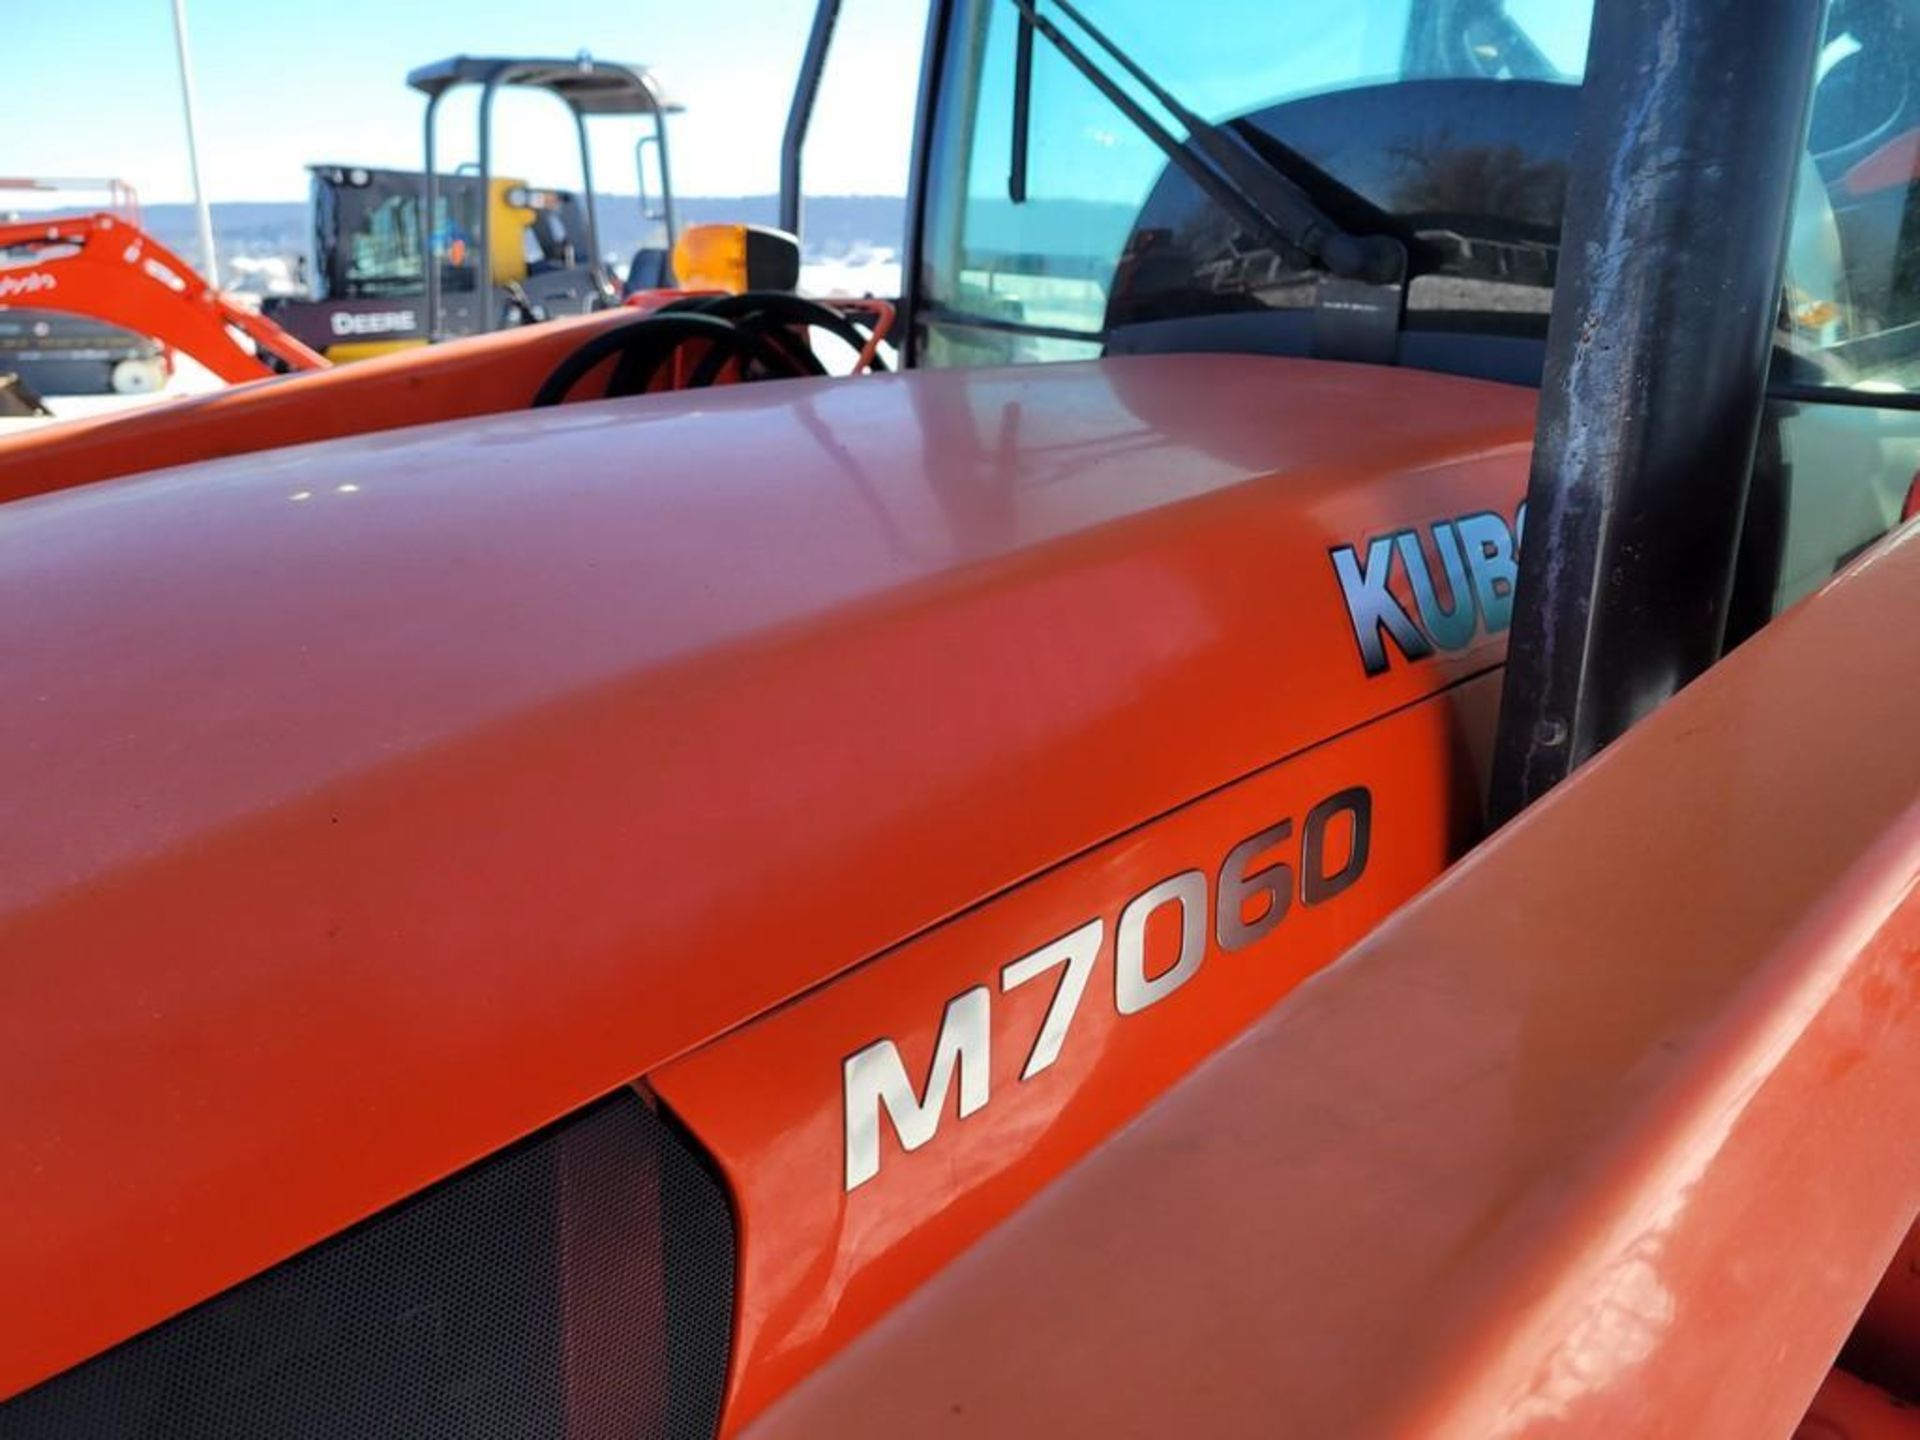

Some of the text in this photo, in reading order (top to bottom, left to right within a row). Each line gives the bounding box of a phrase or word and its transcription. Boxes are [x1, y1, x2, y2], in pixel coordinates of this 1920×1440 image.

[330, 311, 416, 335] DEERE
[1329, 501, 1527, 677] KUB
[841, 785, 1372, 1193] M7060
